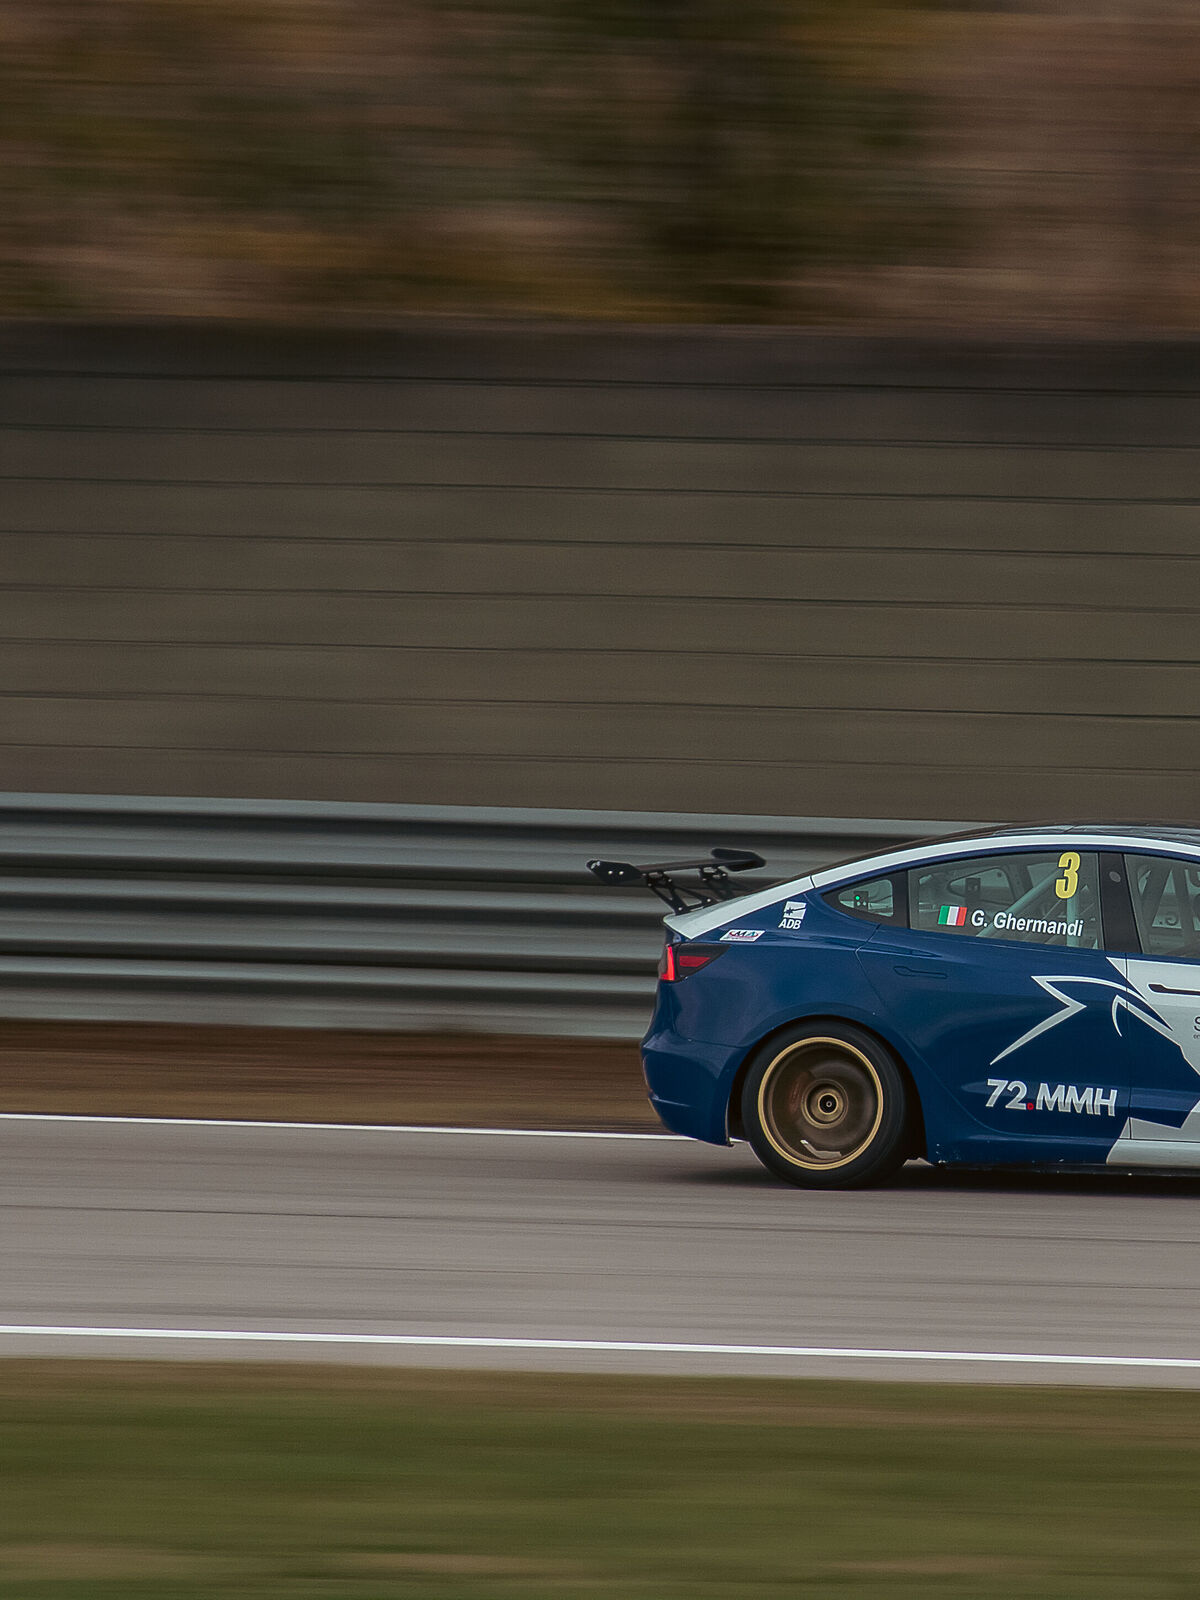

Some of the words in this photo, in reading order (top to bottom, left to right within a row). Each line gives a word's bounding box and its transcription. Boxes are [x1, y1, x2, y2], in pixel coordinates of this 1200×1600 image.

[1056, 851, 1080, 899] 3
[778, 918, 801, 930] ADB
[971, 909, 988, 928] G.
[993, 911, 1084, 937] Ghermandi
[985, 1078, 1118, 1117] 72.MMH
